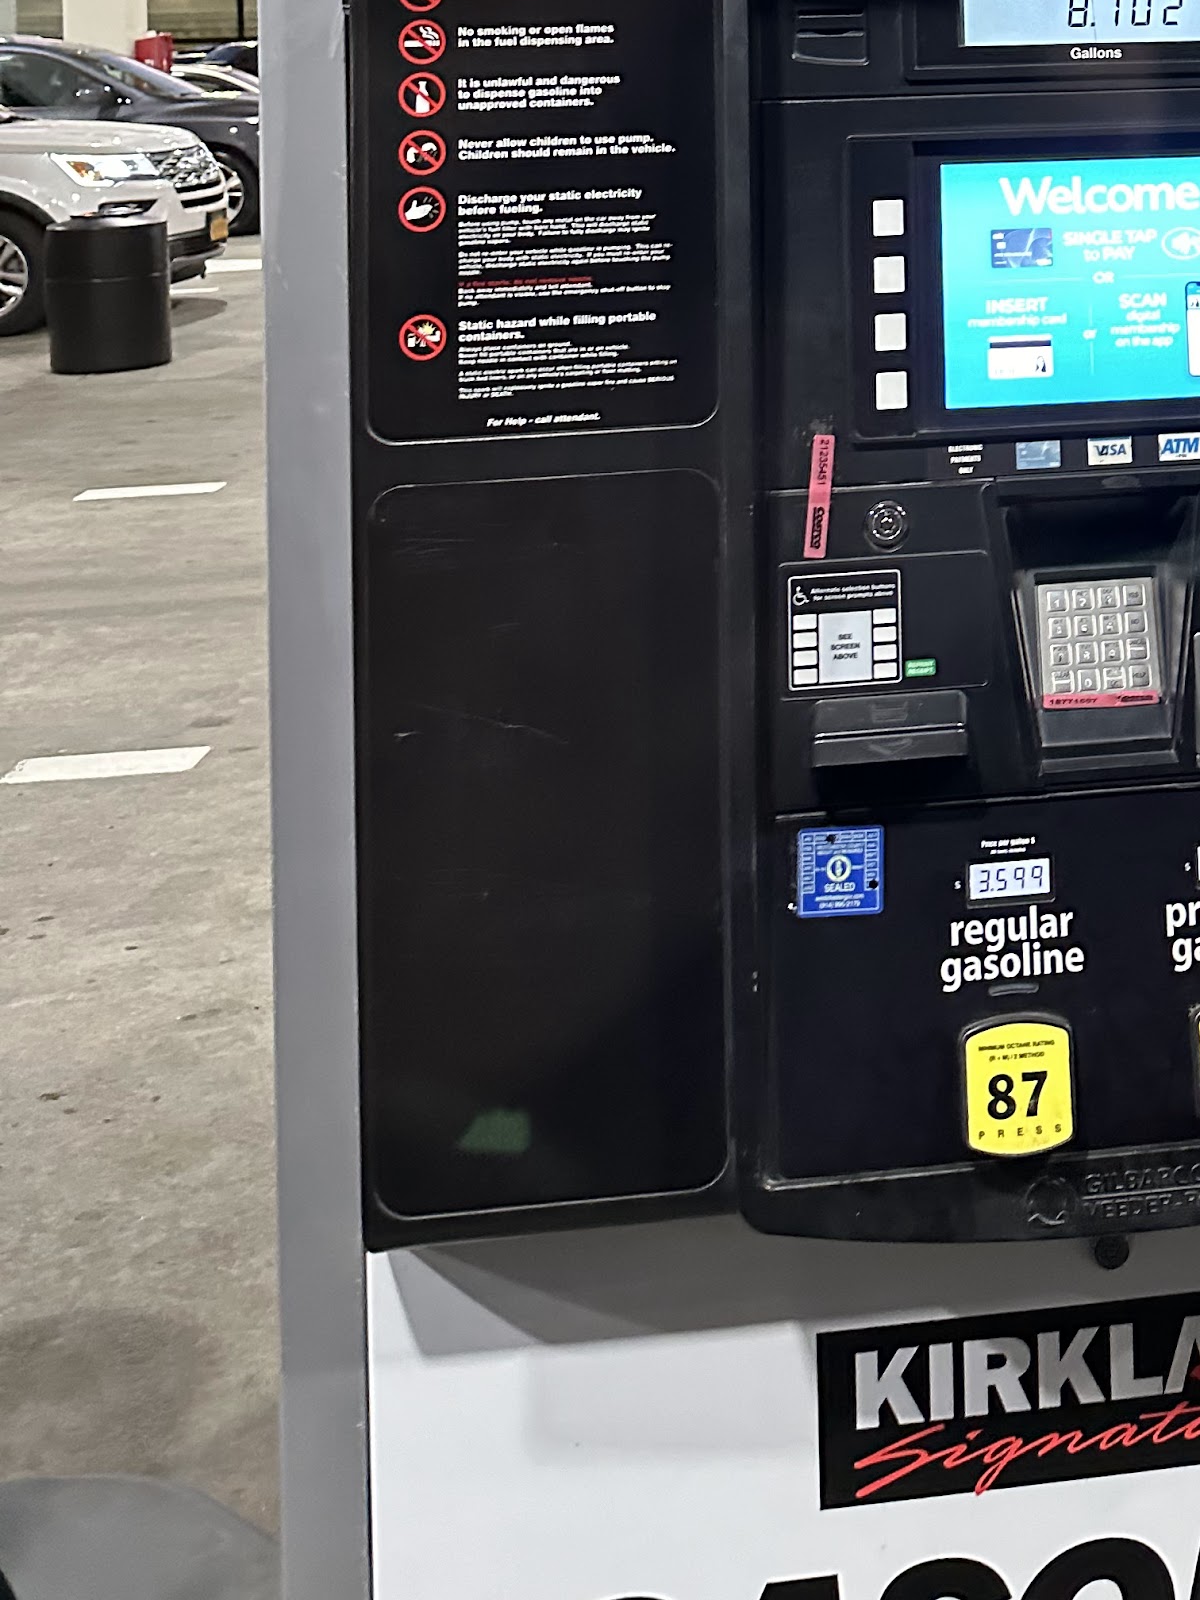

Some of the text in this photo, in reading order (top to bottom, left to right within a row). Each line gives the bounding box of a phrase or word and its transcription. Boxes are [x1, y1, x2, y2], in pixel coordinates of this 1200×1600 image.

[458, 27, 474, 36] No
[477, 26, 526, 37] smoking
[544, 26, 573, 35] open
[575, 24, 614, 34] flames
[458, 38, 469, 47] in
[494, 36, 517, 46] fuel
[520, 35, 582, 47] dispensing
[1070, 47, 1122, 60] Gallons
[458, 75, 620, 88] It is unlawful and dangerous
[458, 85, 602, 99] to dispense gasoline into
[458, 98, 594, 111] unapproved containers.
[458, 139, 493, 149] Never
[496, 138, 528, 148] allow
[531, 136, 576, 147] children
[580, 136, 592, 145] to
[618, 134, 654, 145] pump.
[458, 143, 676, 161] Children should remain in the vehicle.
[458, 188, 642, 205] Discharge your static electricity
[999, 176, 1200, 216] Welcome
[458, 203, 543, 216] before fueling.
[1063, 229, 1157, 246] SINGLE TAP
[1083, 246, 1135, 261] to PAY
[1093, 272, 1114, 284] OR
[986, 297, 1048, 314] INSERT
[1119, 293, 1167, 309] SCAN
[458, 312, 656, 331] Static hazard while filling portable
[458, 331, 525, 342] containers.
[1094, 444, 1126, 456] VISA
[1160, 437, 1200, 453] ATM
[979, 866, 1043, 893] 3.599
[824, 882, 856, 893] SEALED
[950, 905, 1073, 952] regular
[940, 942, 1084, 992] gasoline
[987, 1070, 1047, 1120] 87
